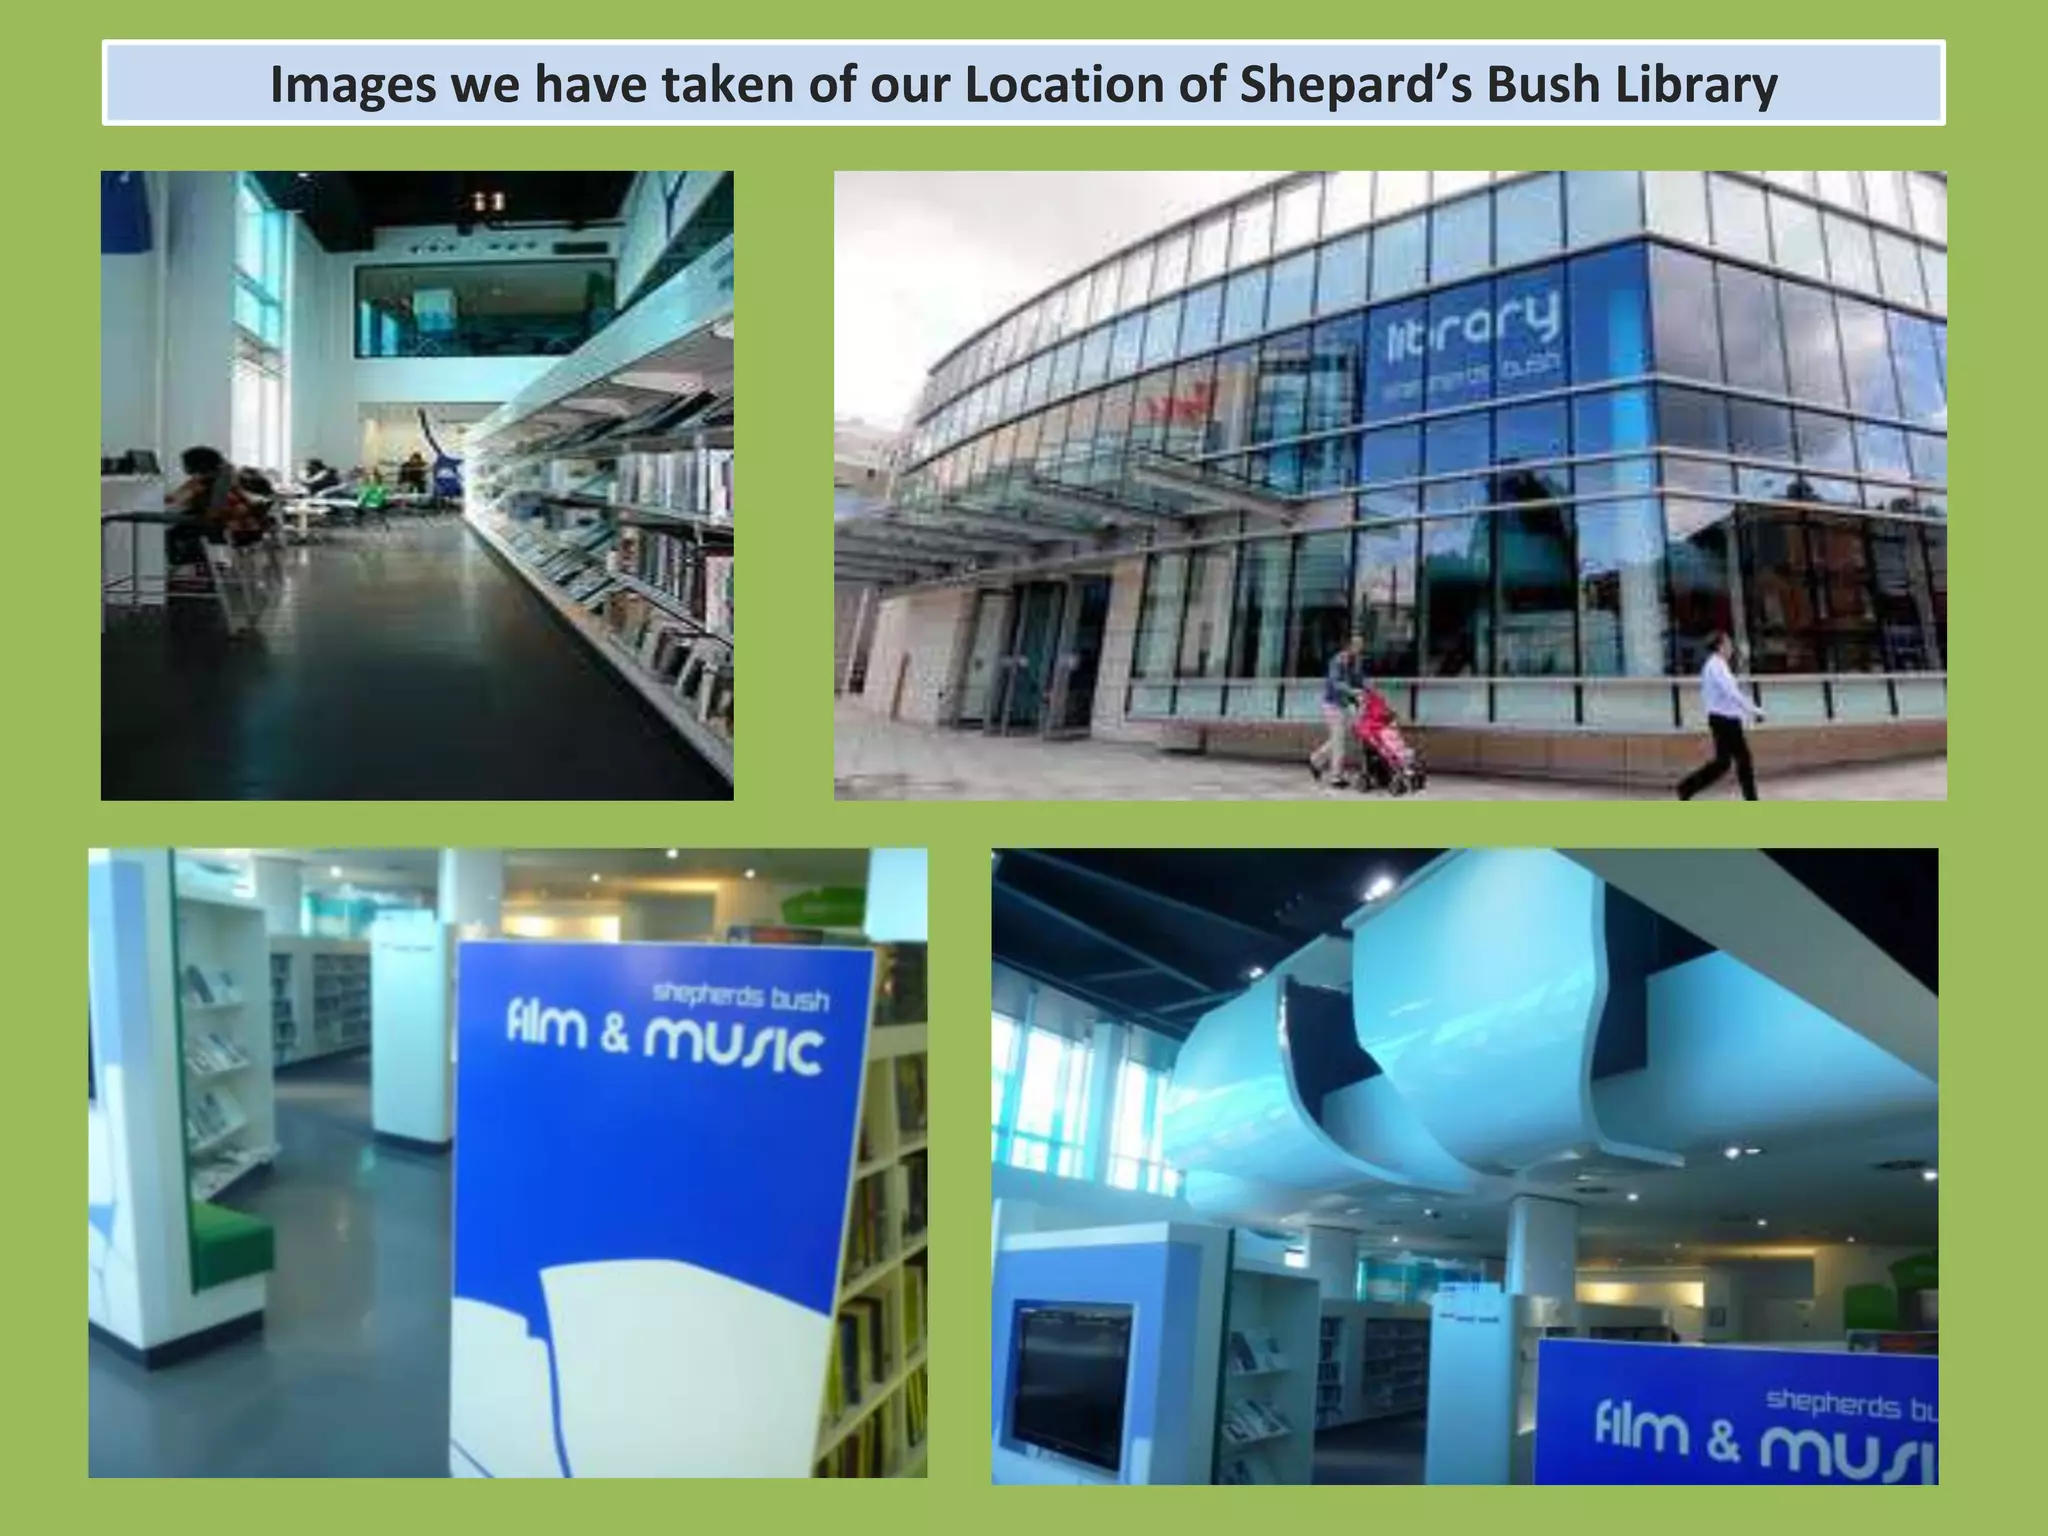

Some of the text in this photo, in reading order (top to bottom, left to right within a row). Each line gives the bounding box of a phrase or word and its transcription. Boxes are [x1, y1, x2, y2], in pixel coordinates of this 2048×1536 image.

[653, 981, 830, 1013] shepherds bush
[507, 997, 588, 1049] film
[601, 1012, 630, 1054] &
[1766, 1388, 1938, 1423] shepherds bu
[1595, 1399, 1936, 1484] film & musi
